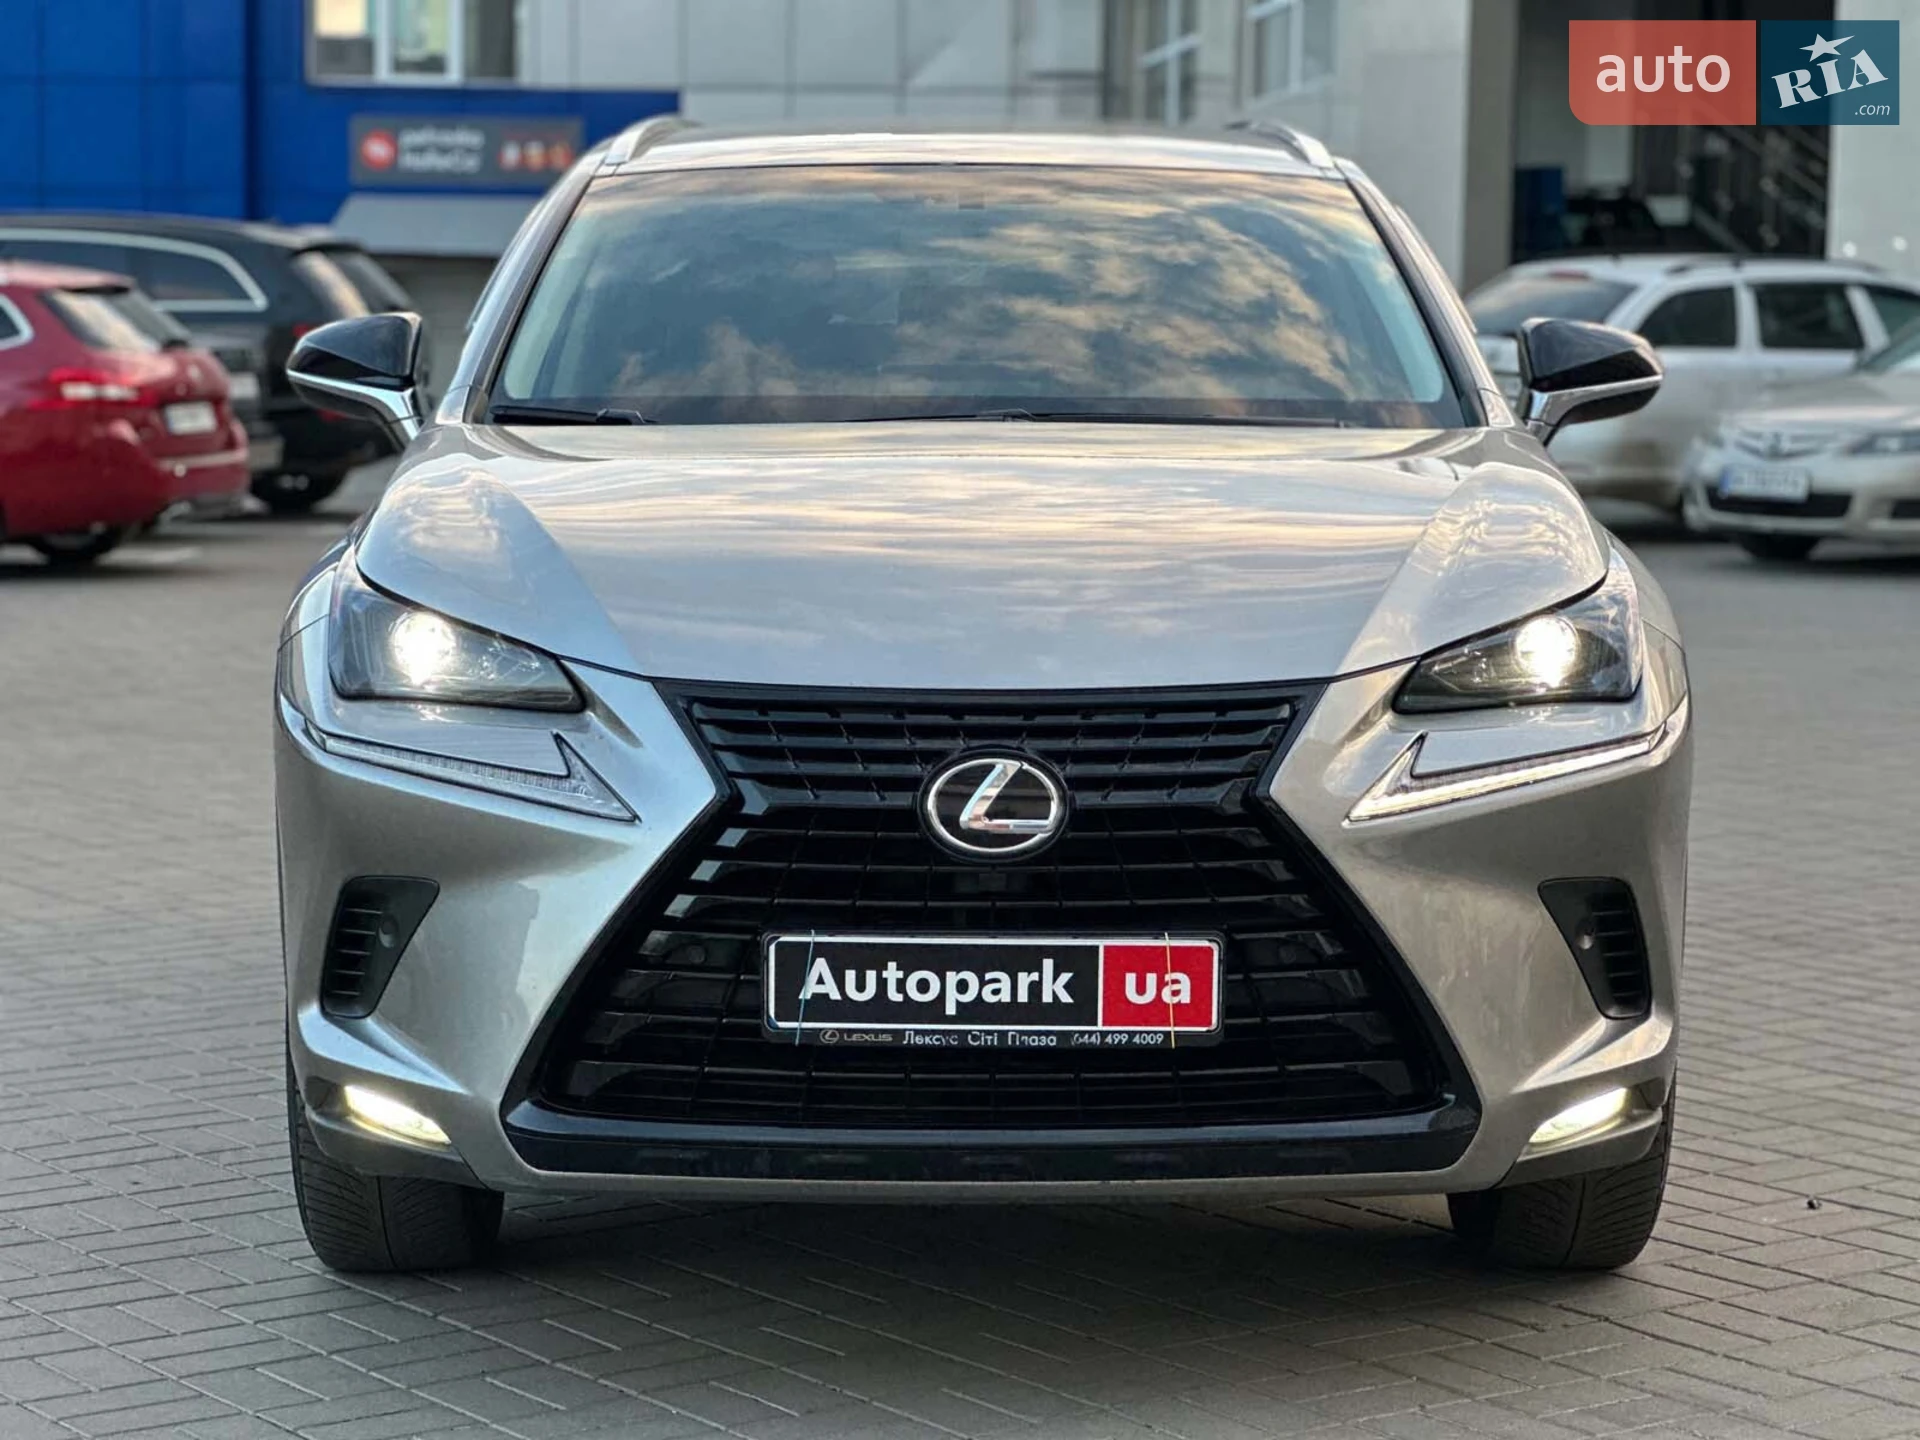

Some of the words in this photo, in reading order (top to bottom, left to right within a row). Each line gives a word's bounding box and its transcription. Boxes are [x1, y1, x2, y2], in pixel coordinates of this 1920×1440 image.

[799, 957, 1074, 1016] Autopark
[1124, 972, 1192, 1005] ua
[843, 1032, 893, 1042] LEXUS
[1105, 1032, 1128, 1045] 499
[1132, 1032, 1164, 1045] 4009
